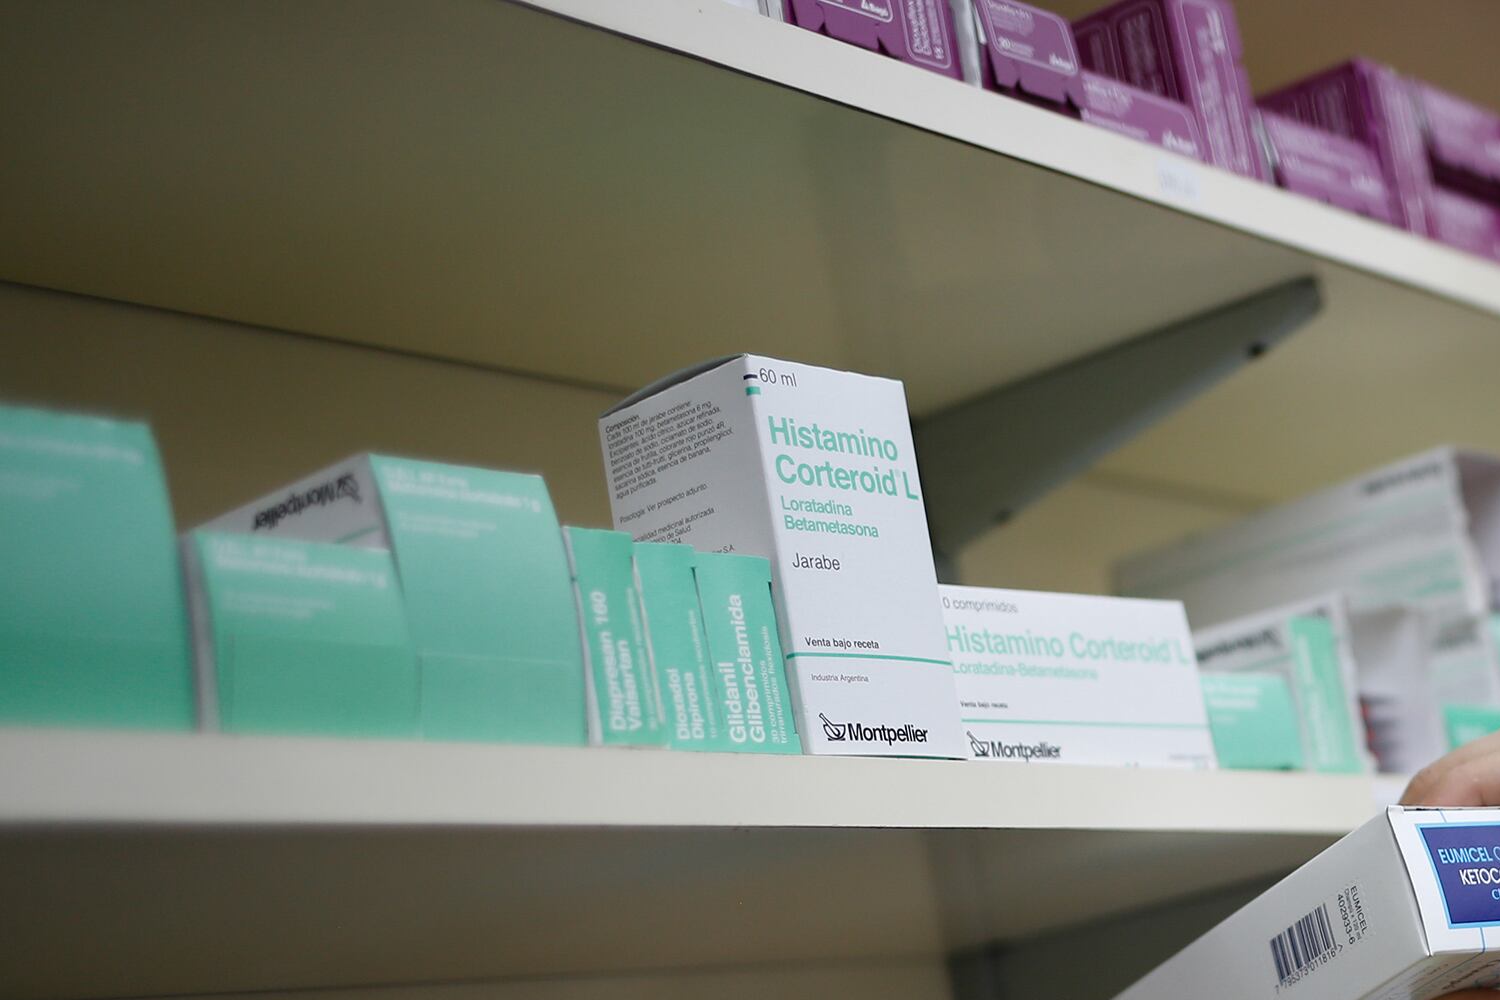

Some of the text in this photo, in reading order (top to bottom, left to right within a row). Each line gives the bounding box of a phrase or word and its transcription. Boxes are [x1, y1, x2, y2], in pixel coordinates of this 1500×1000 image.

[759, 368, 797, 387] 60 ml
[768, 416, 898, 461] Histamino
[903, 471, 919, 500] L
[781, 496, 853, 516] Loratadina
[784, 515, 879, 538] Betametasona
[792, 552, 841, 570] Jarabe
[942, 597, 1018, 614] 0 comprimidos
[805, 637, 879, 650] Venta bajo receta
[944, 624, 1064, 657] Histamino
[729, 594, 766, 743] Glibenclamida
[811, 674, 869, 683] Industria Argentina
[718, 662, 747, 743] Glidanil
[848, 723, 928, 745] Montpellier
[991, 741, 1061, 763] Montpellier
[1438, 847, 1492, 864] EUMICEL
[1337, 894, 1356, 945] 402933-6
[1350, 885, 1368, 934] EUMICEL
